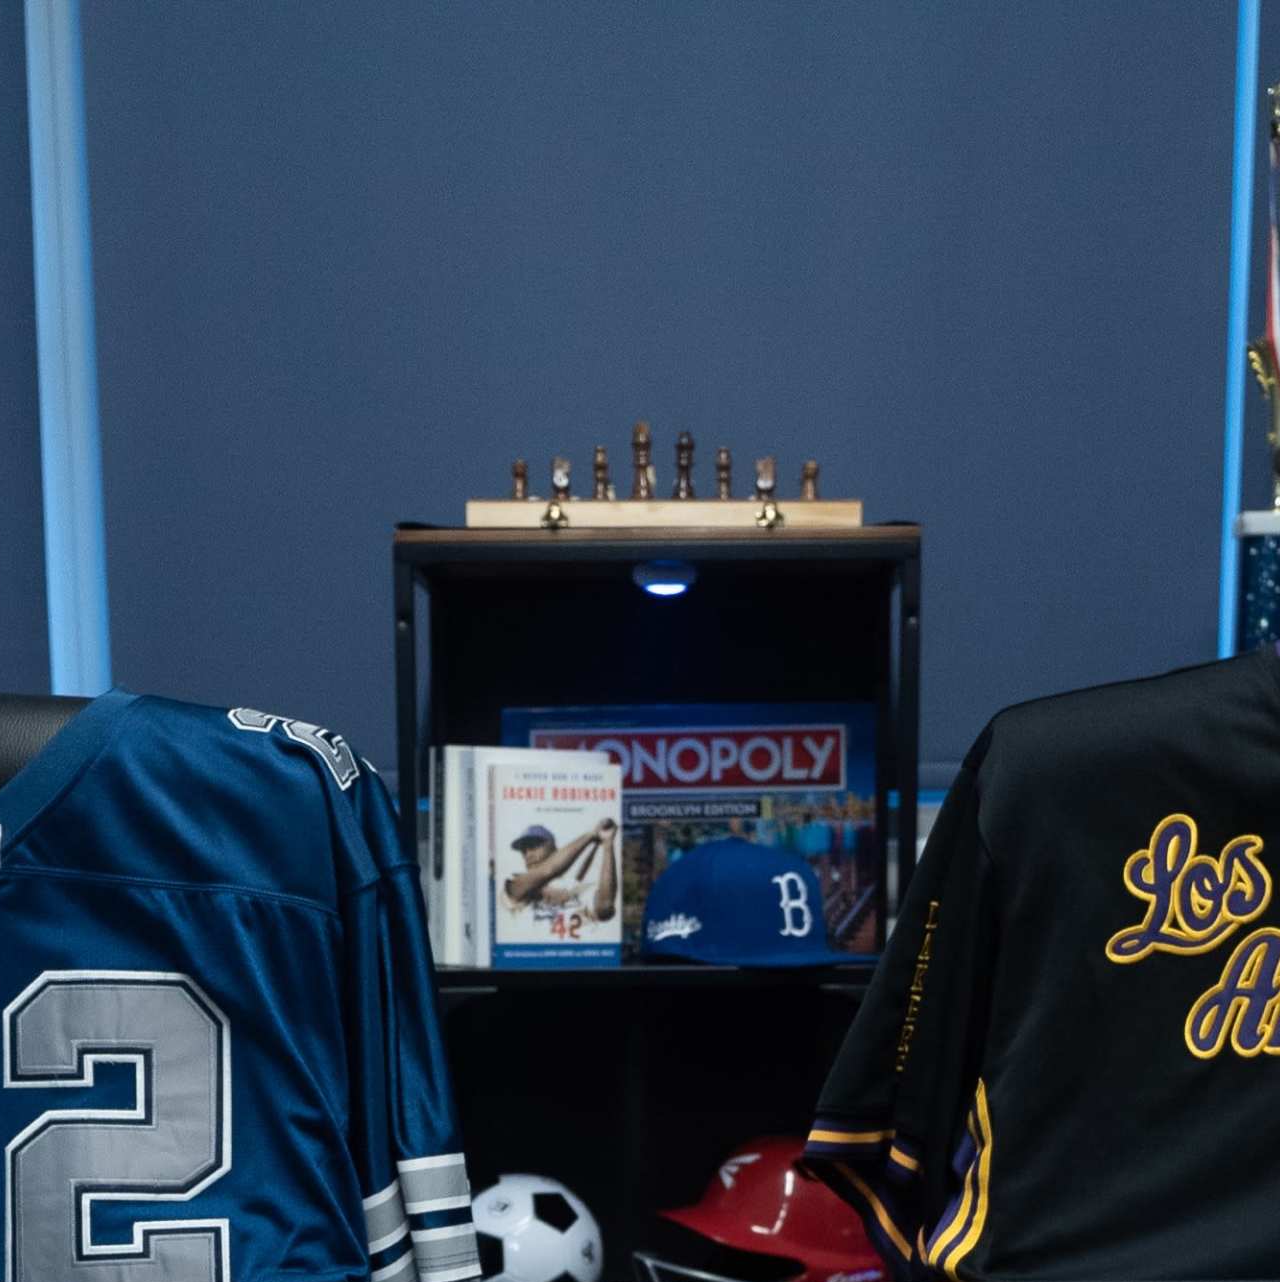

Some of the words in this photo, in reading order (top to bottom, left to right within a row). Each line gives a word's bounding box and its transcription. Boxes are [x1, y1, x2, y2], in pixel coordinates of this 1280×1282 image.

[538, 735, 836, 783] ONOPOLY
[629, 803, 701, 818] BROOKLYN
[704, 801, 757, 817] EDITION
[772, 872, 813, 938] B
[1105, 813, 1273, 963] Los
[550, 911, 582, 940] 42
